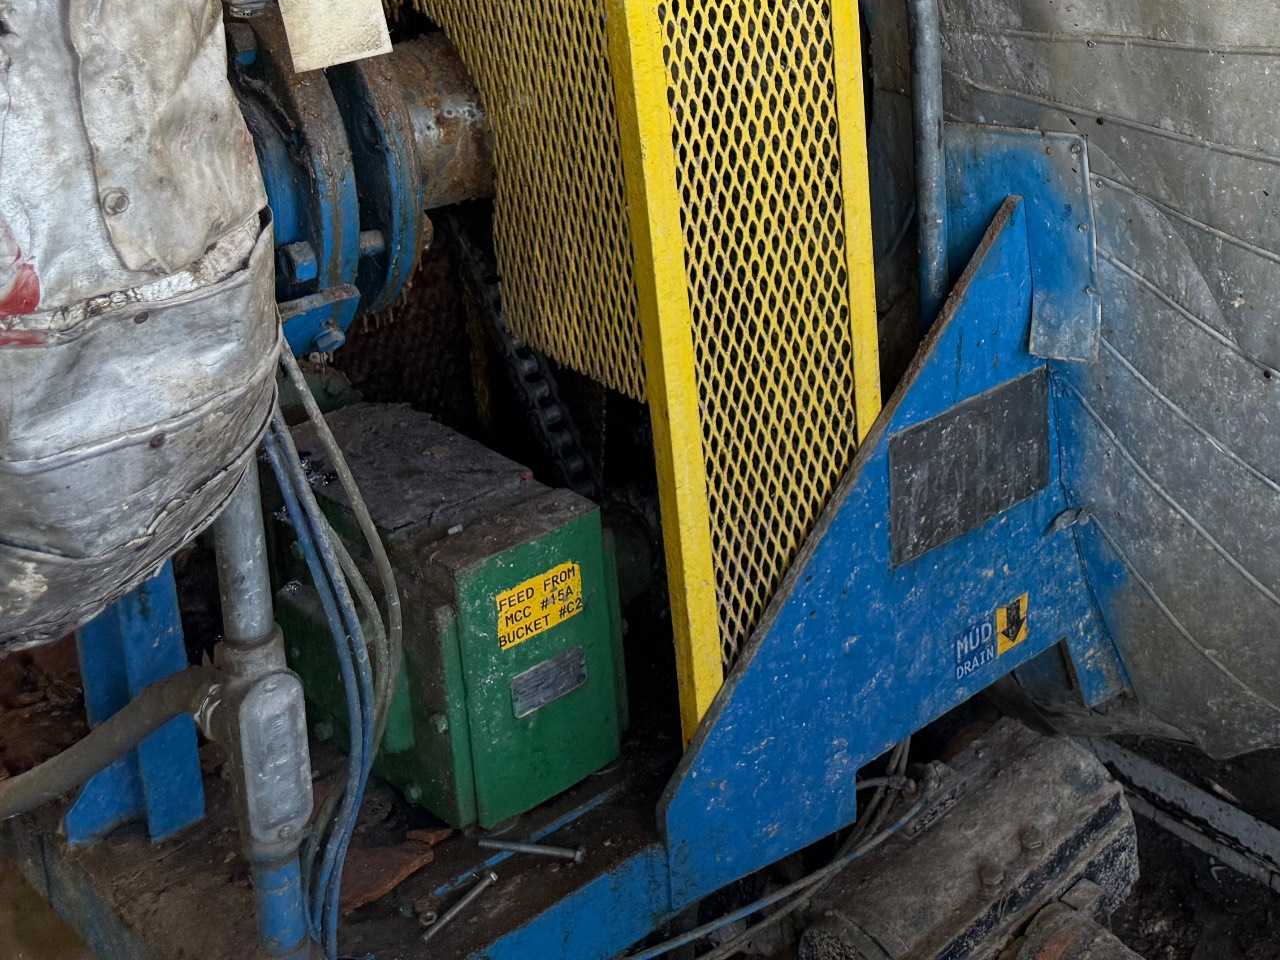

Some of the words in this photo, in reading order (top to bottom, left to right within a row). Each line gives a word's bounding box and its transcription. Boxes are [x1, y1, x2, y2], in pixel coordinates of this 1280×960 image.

[499, 587, 535, 612] FEED
[544, 566, 576, 592] FROM
[505, 606, 532, 627] MCC
[540, 585, 574, 611] #15A
[499, 614, 551, 648] BUCKET
[559, 597, 584, 618] #C2
[957, 622, 992, 664] MUD
[956, 645, 994, 680] DRAIN
